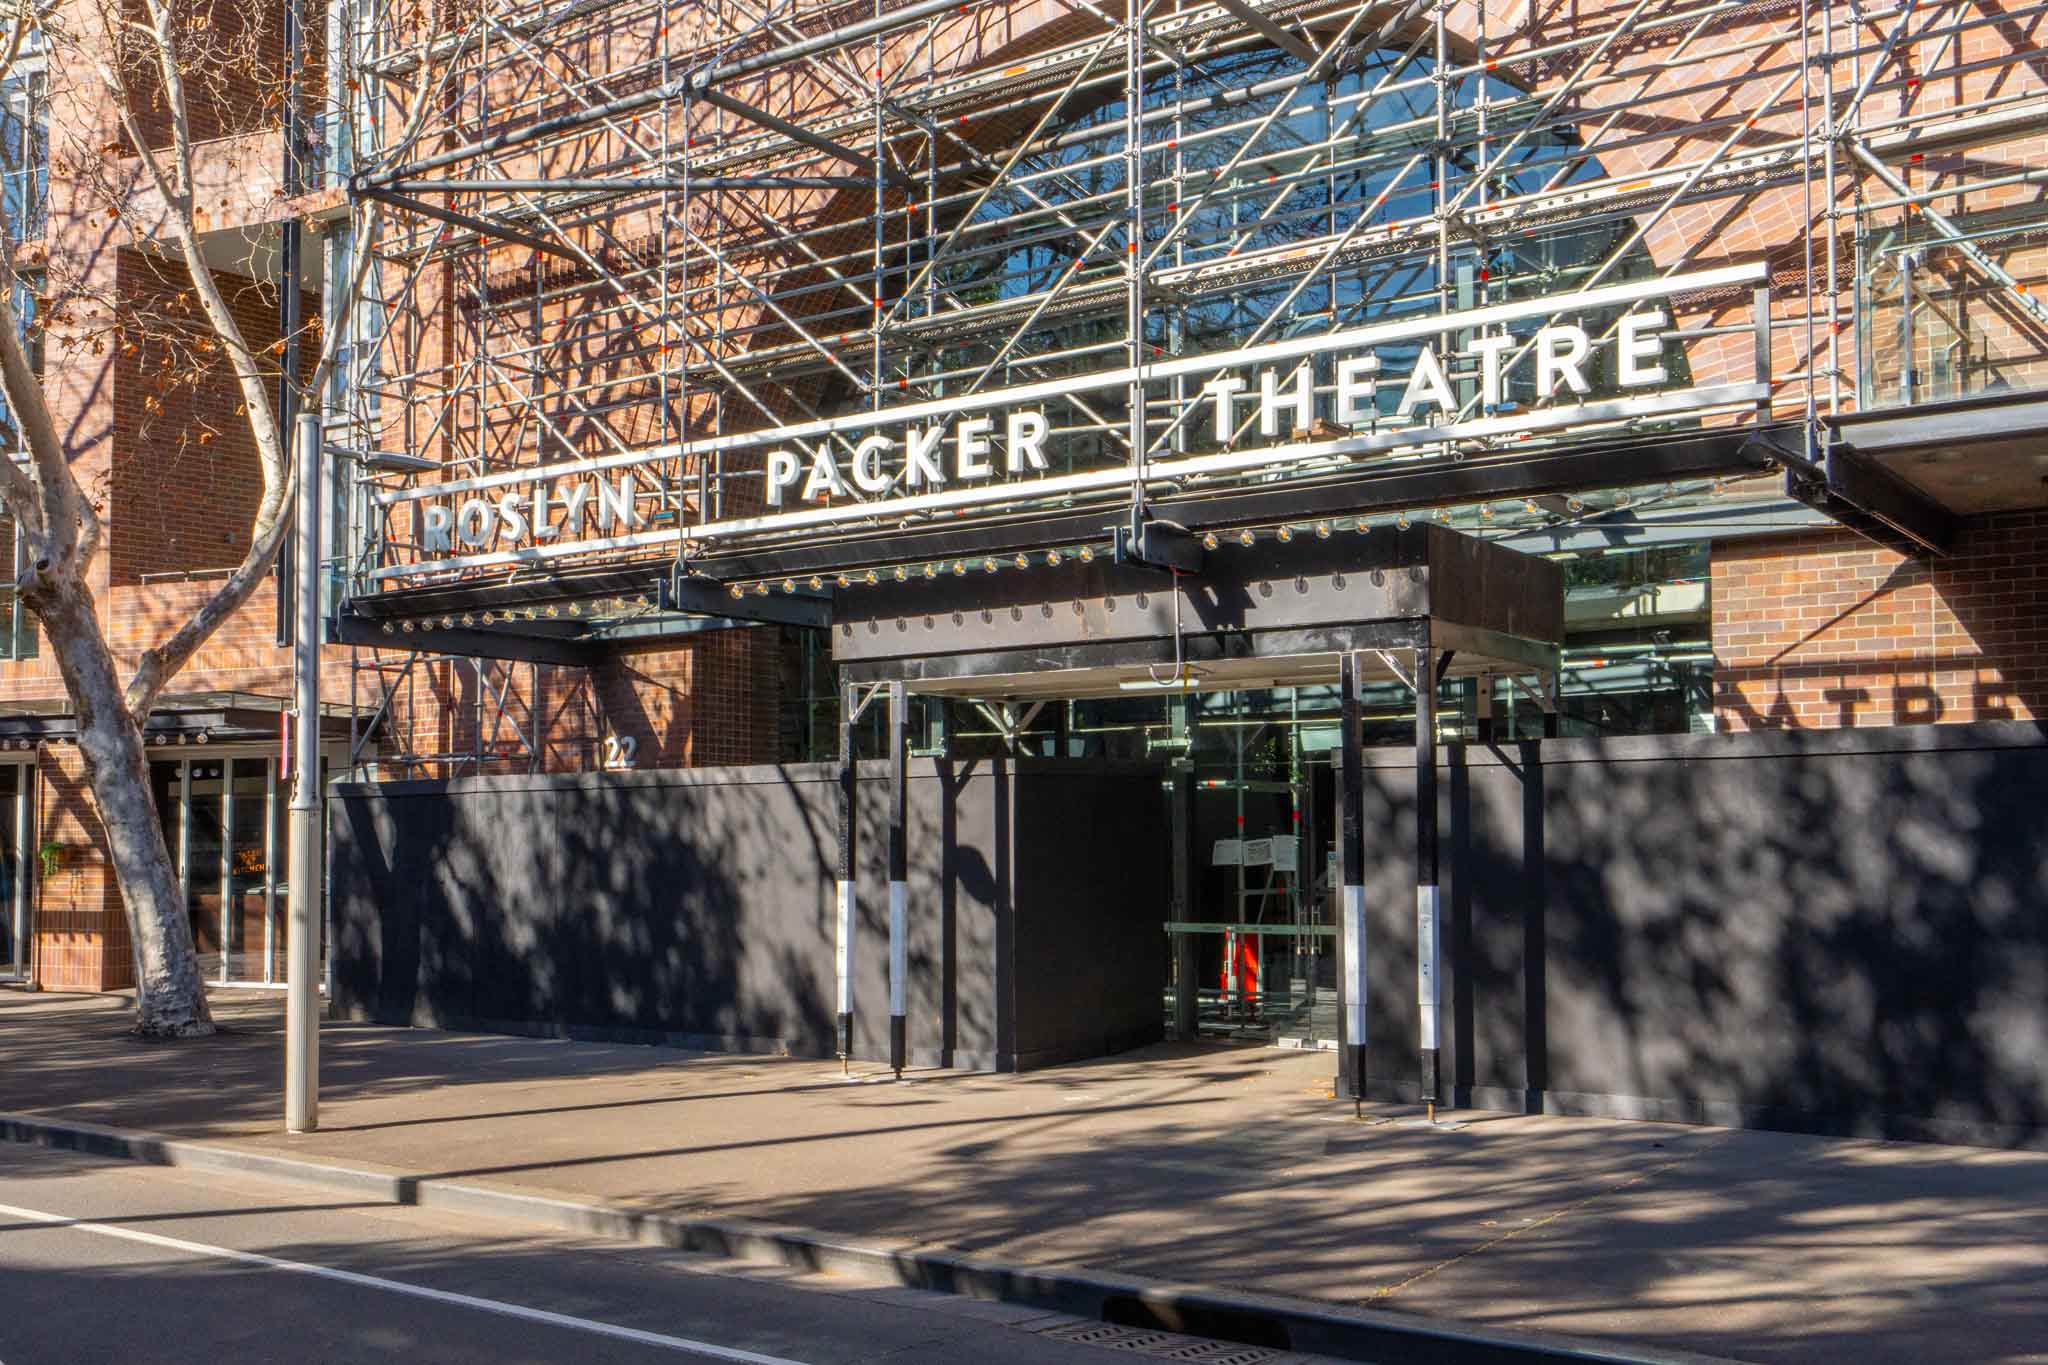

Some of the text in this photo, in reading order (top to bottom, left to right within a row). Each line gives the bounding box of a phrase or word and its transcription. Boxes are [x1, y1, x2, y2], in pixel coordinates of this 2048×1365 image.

[424, 311, 1670, 552] ROSLYN PACKER THEATRE
[604, 735, 640, 768] 22
